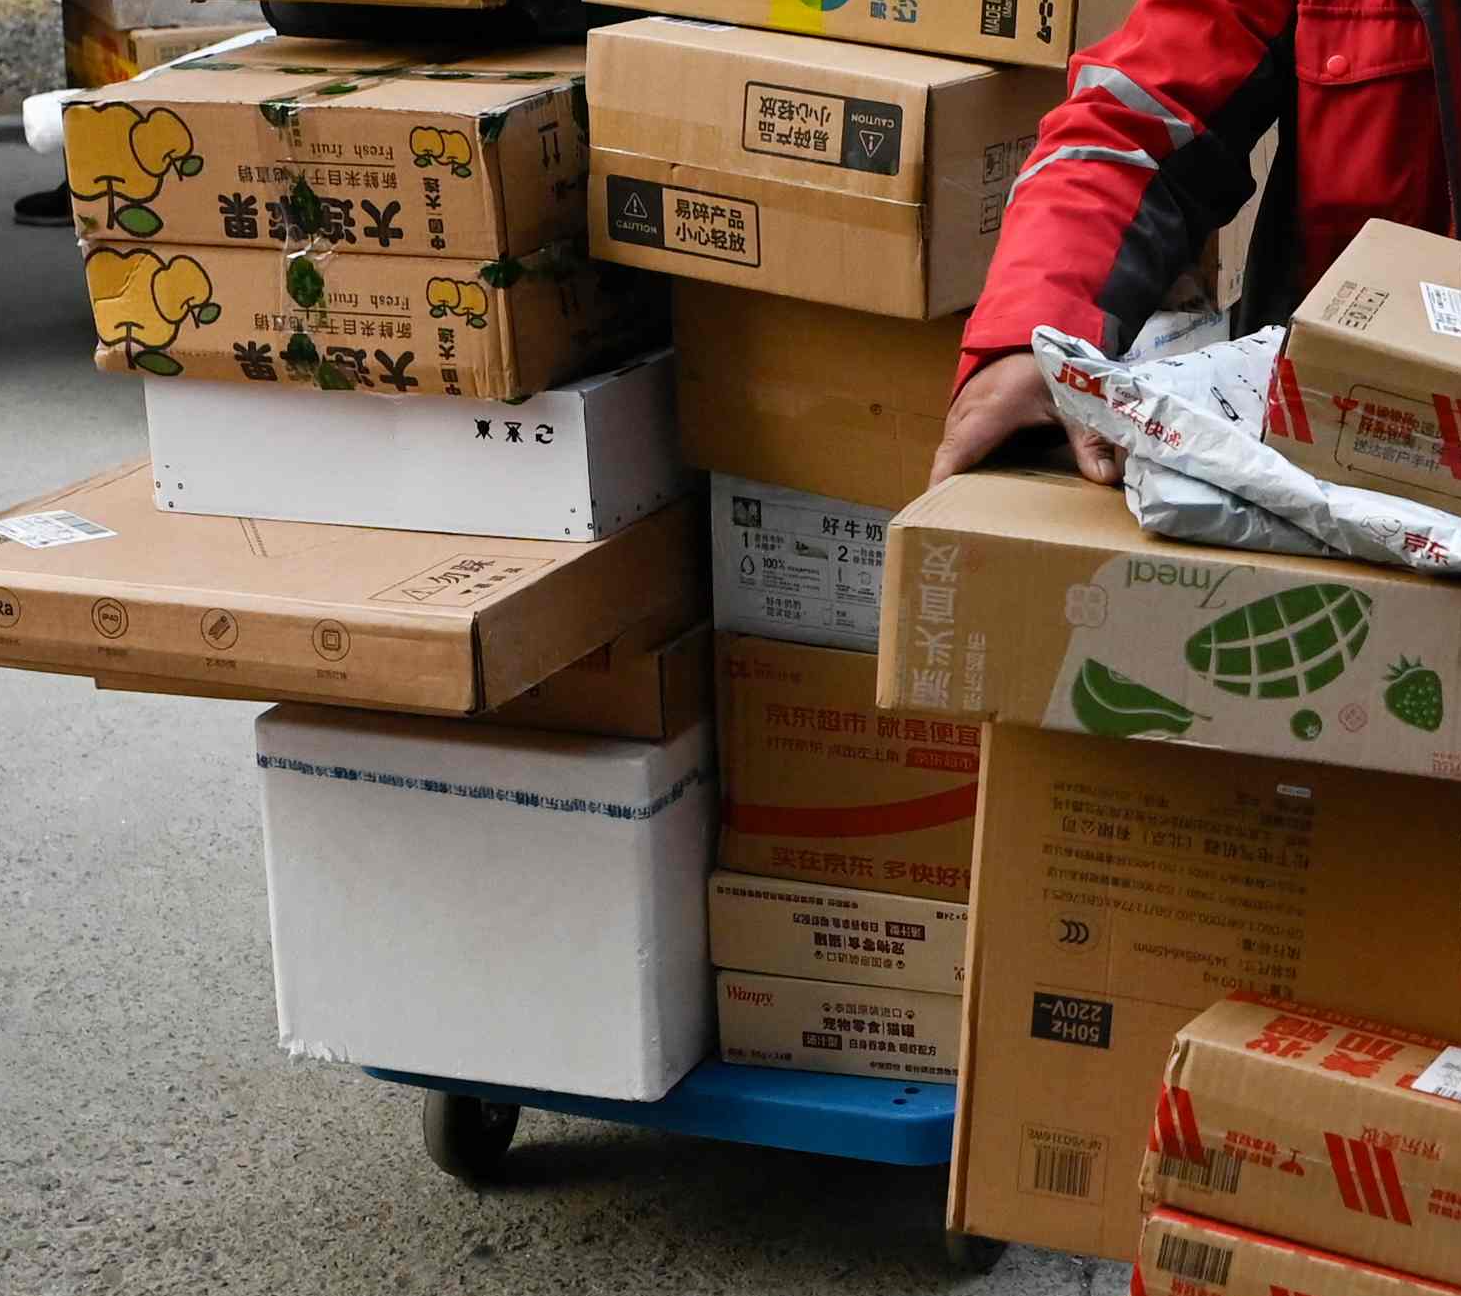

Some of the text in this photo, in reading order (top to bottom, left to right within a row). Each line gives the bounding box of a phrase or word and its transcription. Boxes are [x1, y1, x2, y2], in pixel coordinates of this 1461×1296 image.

[984, 5, 1001, 33] MADE
[759, 94, 832, 127] 小心轻放
[850, 111, 896, 128] CAUTION
[757, 119, 830, 153] 易碎产品
[309, 143, 394, 160] Fresh fruit
[615, 219, 658, 234] CAUTION
[674, 198, 745, 230] 易碎产品
[675, 226, 747, 255] 小心轻放
[328, 293, 410, 310] Fresh fruit
[821, 515, 884, 543] 好牛奶
[837, 544, 849, 563] 2
[1401, 531, 1451, 566] 京东
[765, 703, 980, 747] 京东超市 就是便宜
[1061, 817, 1130, 840] 有限公司
[770, 846, 875, 880] 买在京东
[726, 983, 774, 1007] Wanpy
[1050, 1020, 1100, 1043] 50Hz
